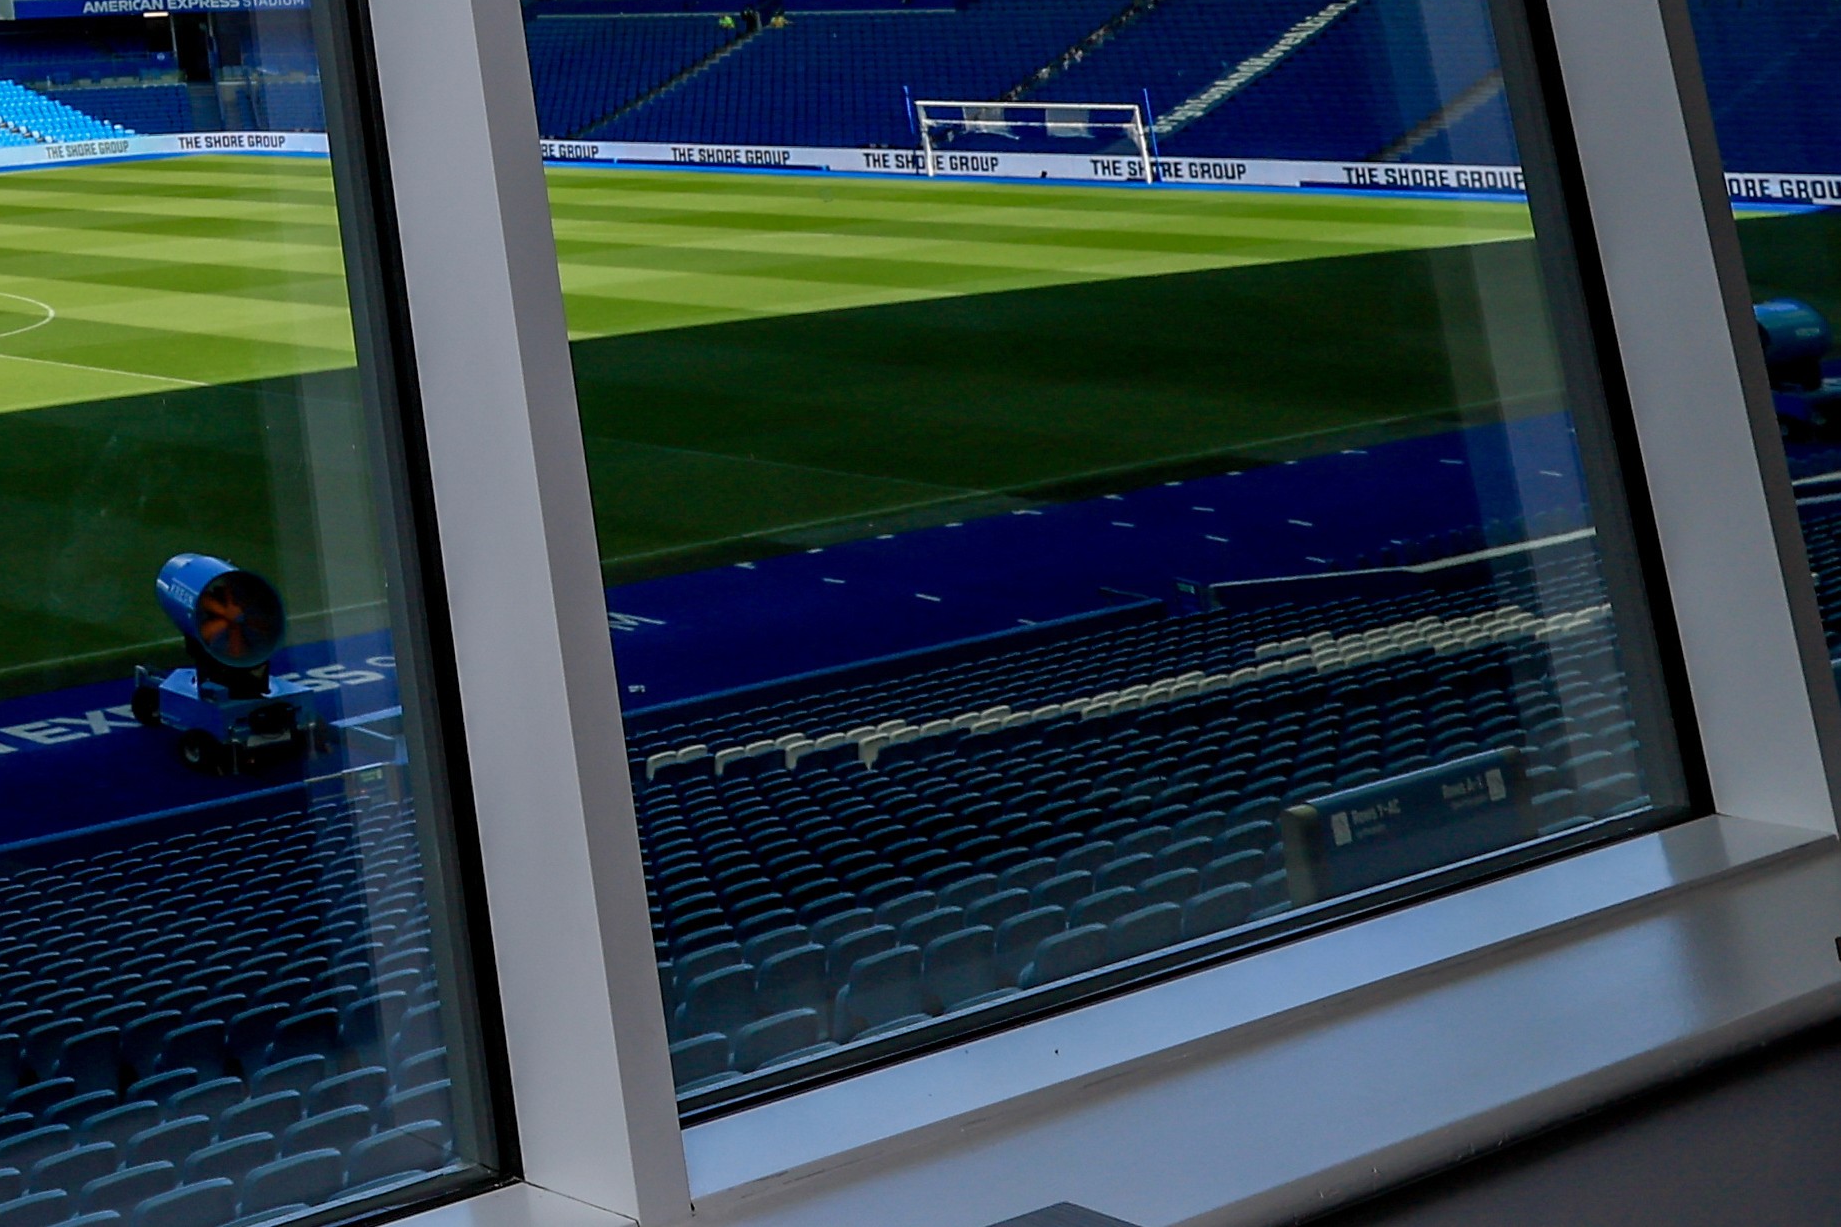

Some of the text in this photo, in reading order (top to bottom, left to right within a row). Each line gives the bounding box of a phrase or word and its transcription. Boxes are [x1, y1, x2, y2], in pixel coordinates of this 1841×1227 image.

[46, 140, 130, 160] THE SHORE GROUP
[178, 134, 286, 150] THE SHORE GROUP
[558, 144, 599, 160] GROUP
[671, 147, 791, 166] THE SHORE GROUP
[862, 152, 891, 169] THE
[949, 155, 999, 172] GROUP
[1090, 159, 1123, 177] THE
[1188, 162, 1247, 181] GROUP
[1342, 166, 1380, 185] THE
[1385, 168, 1450, 187] SHORE
[1728, 178, 1841, 199] ORE GROU
